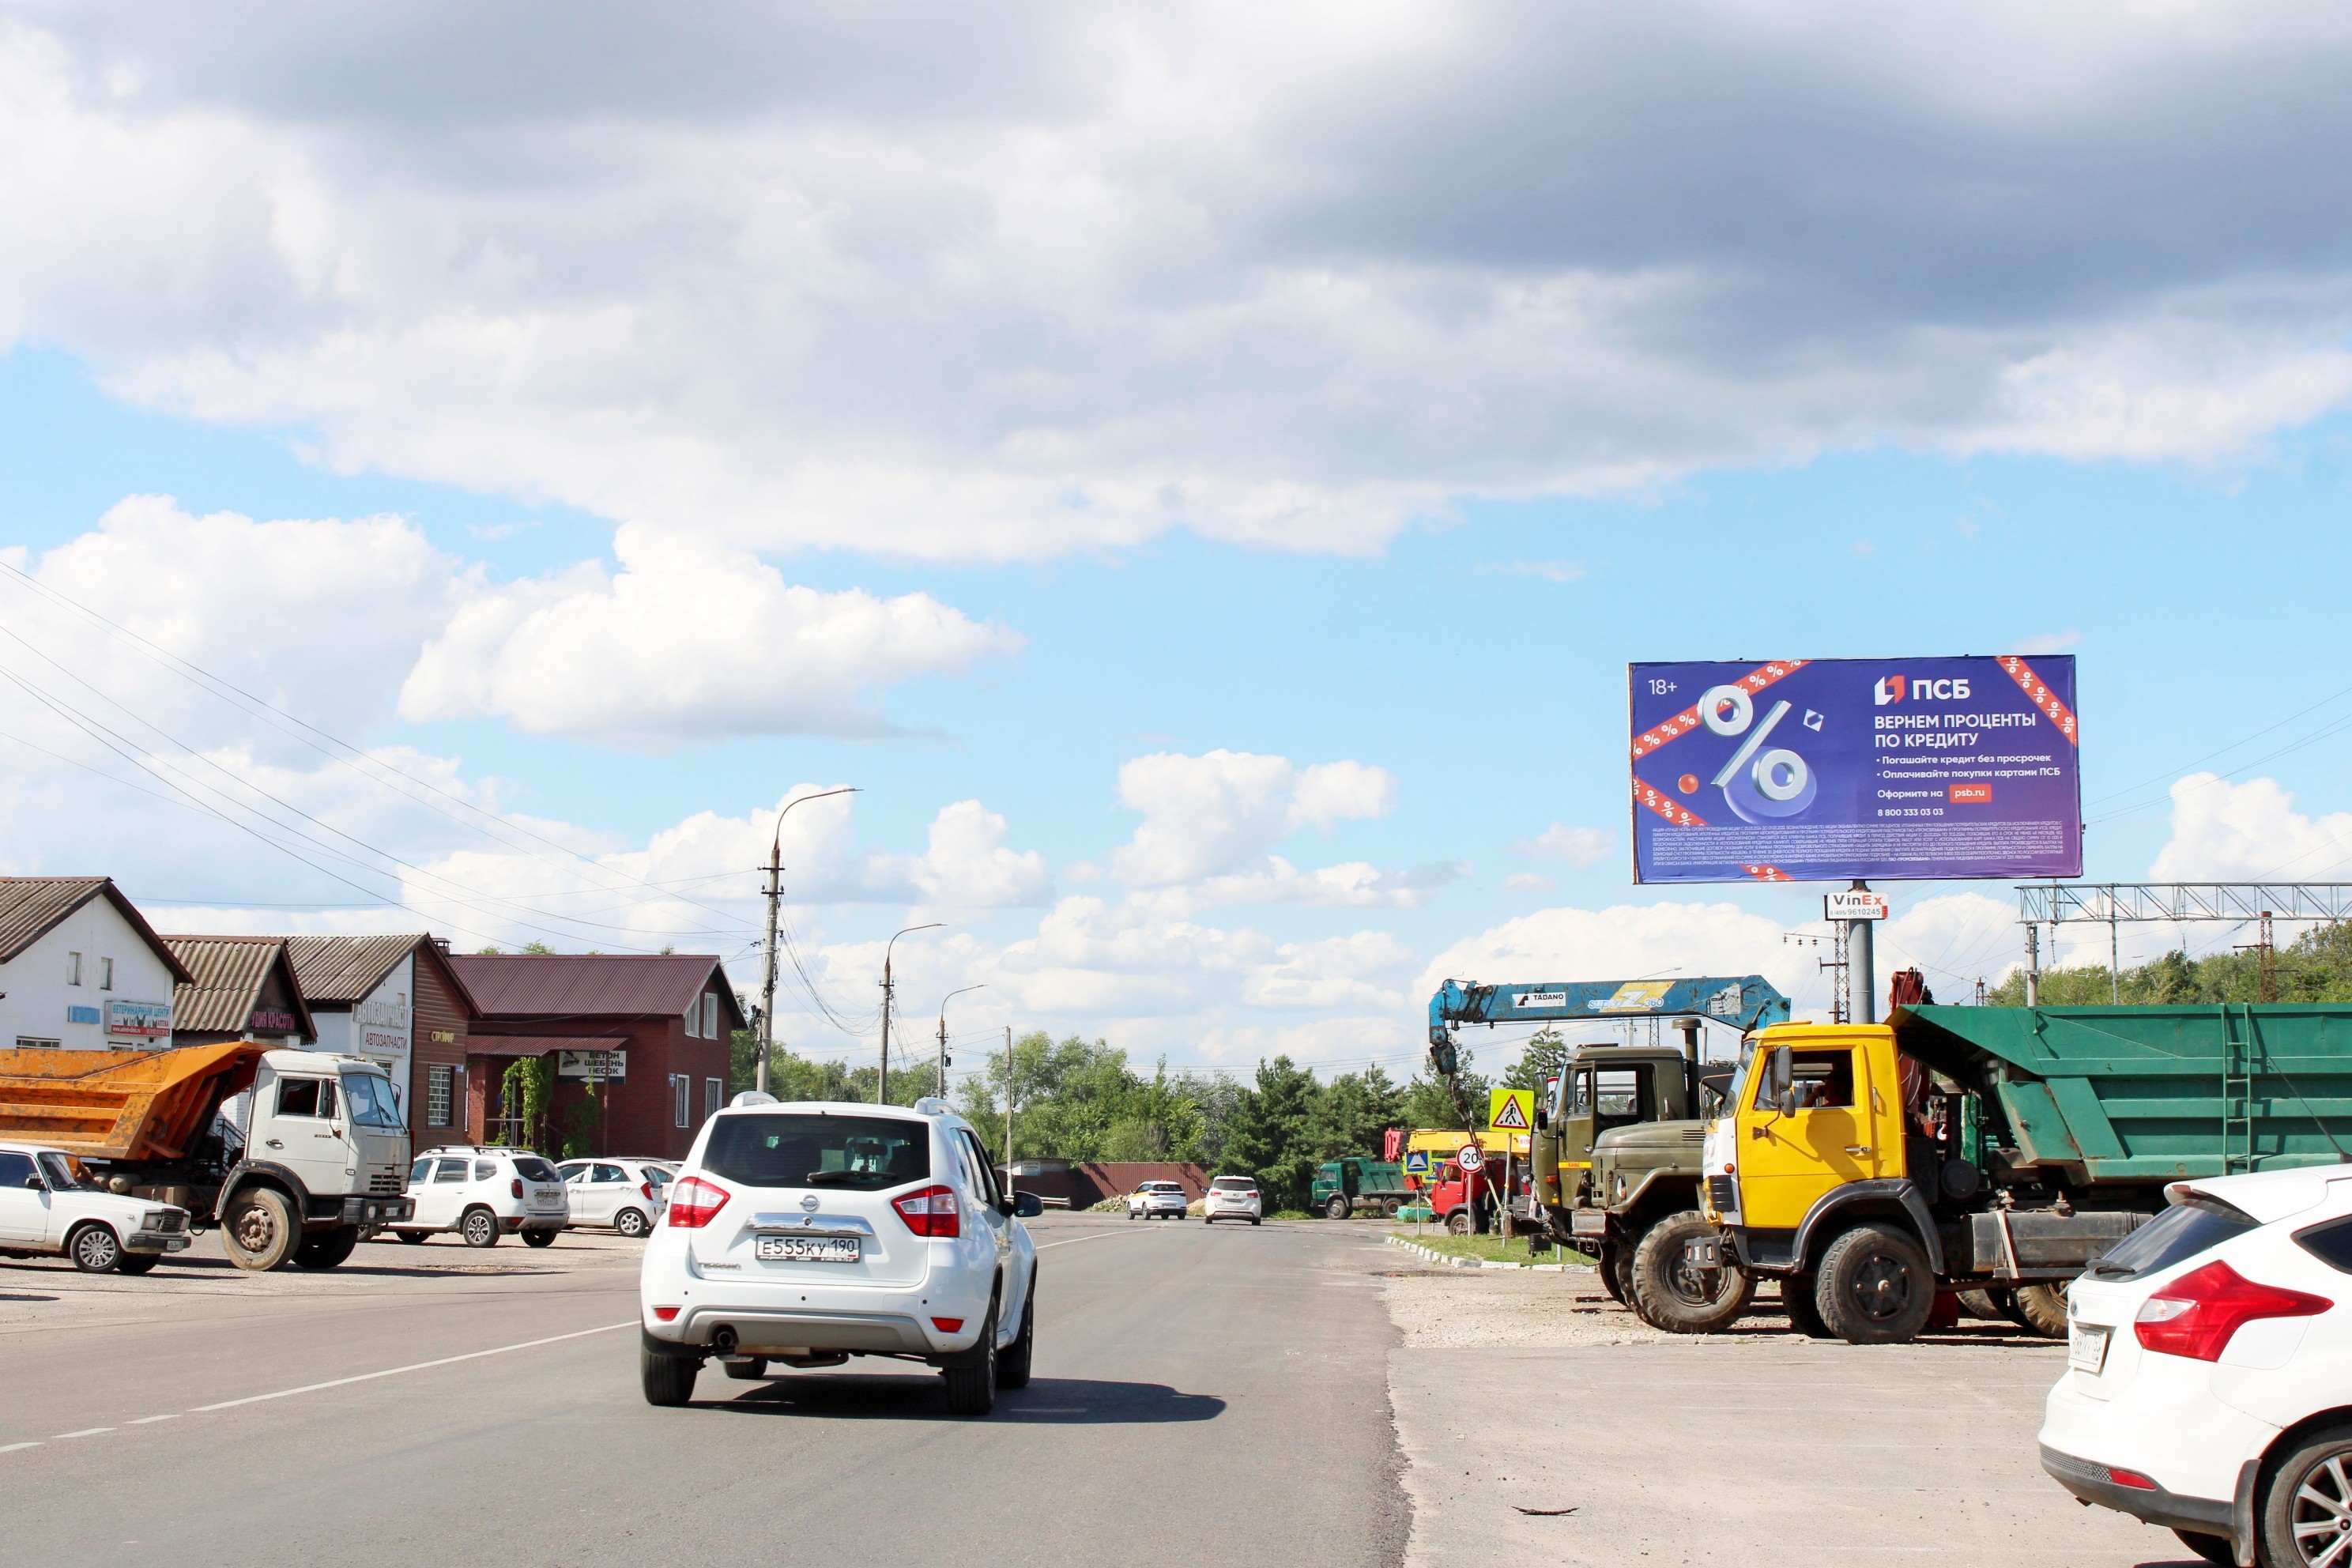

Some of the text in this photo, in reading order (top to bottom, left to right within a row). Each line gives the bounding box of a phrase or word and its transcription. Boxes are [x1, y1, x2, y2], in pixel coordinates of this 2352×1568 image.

[1648, 679, 1677, 695] 18+
[1913, 679, 1970, 699] ПСБ
[1874, 713, 2036, 729] ВЕРНЕМ ПРОЦЕНТЫ
[1875, 733, 1979, 748] ПО КРЕДИТУ
[1882, 755, 2052, 766] Погашайте кредит без просрочек
[1882, 767, 2060, 779] Оплачивайте покупки картами ПСБ
[1877, 790, 1928, 799] Оформите
[1954, 788, 1985, 798] psb.ru
[1834, 895, 1883, 906] VinEx
[1645, 997, 1664, 1008] 360
[113, 1004, 153, 1017] ВЕТЕРИНАРНЫЙ
[154, 1008, 170, 1018] ЦЕНТР
[356, 1001, 413, 1029] АВТОЗАПЧАСТИ
[249, 1011, 296, 1030] УДИЯ КРАСОТЫ
[365, 1032, 408, 1050] АВТОЗАПЧАСТИ
[1464, 1152, 1480, 1164] 20
[831, 1239, 855, 1252] 190
